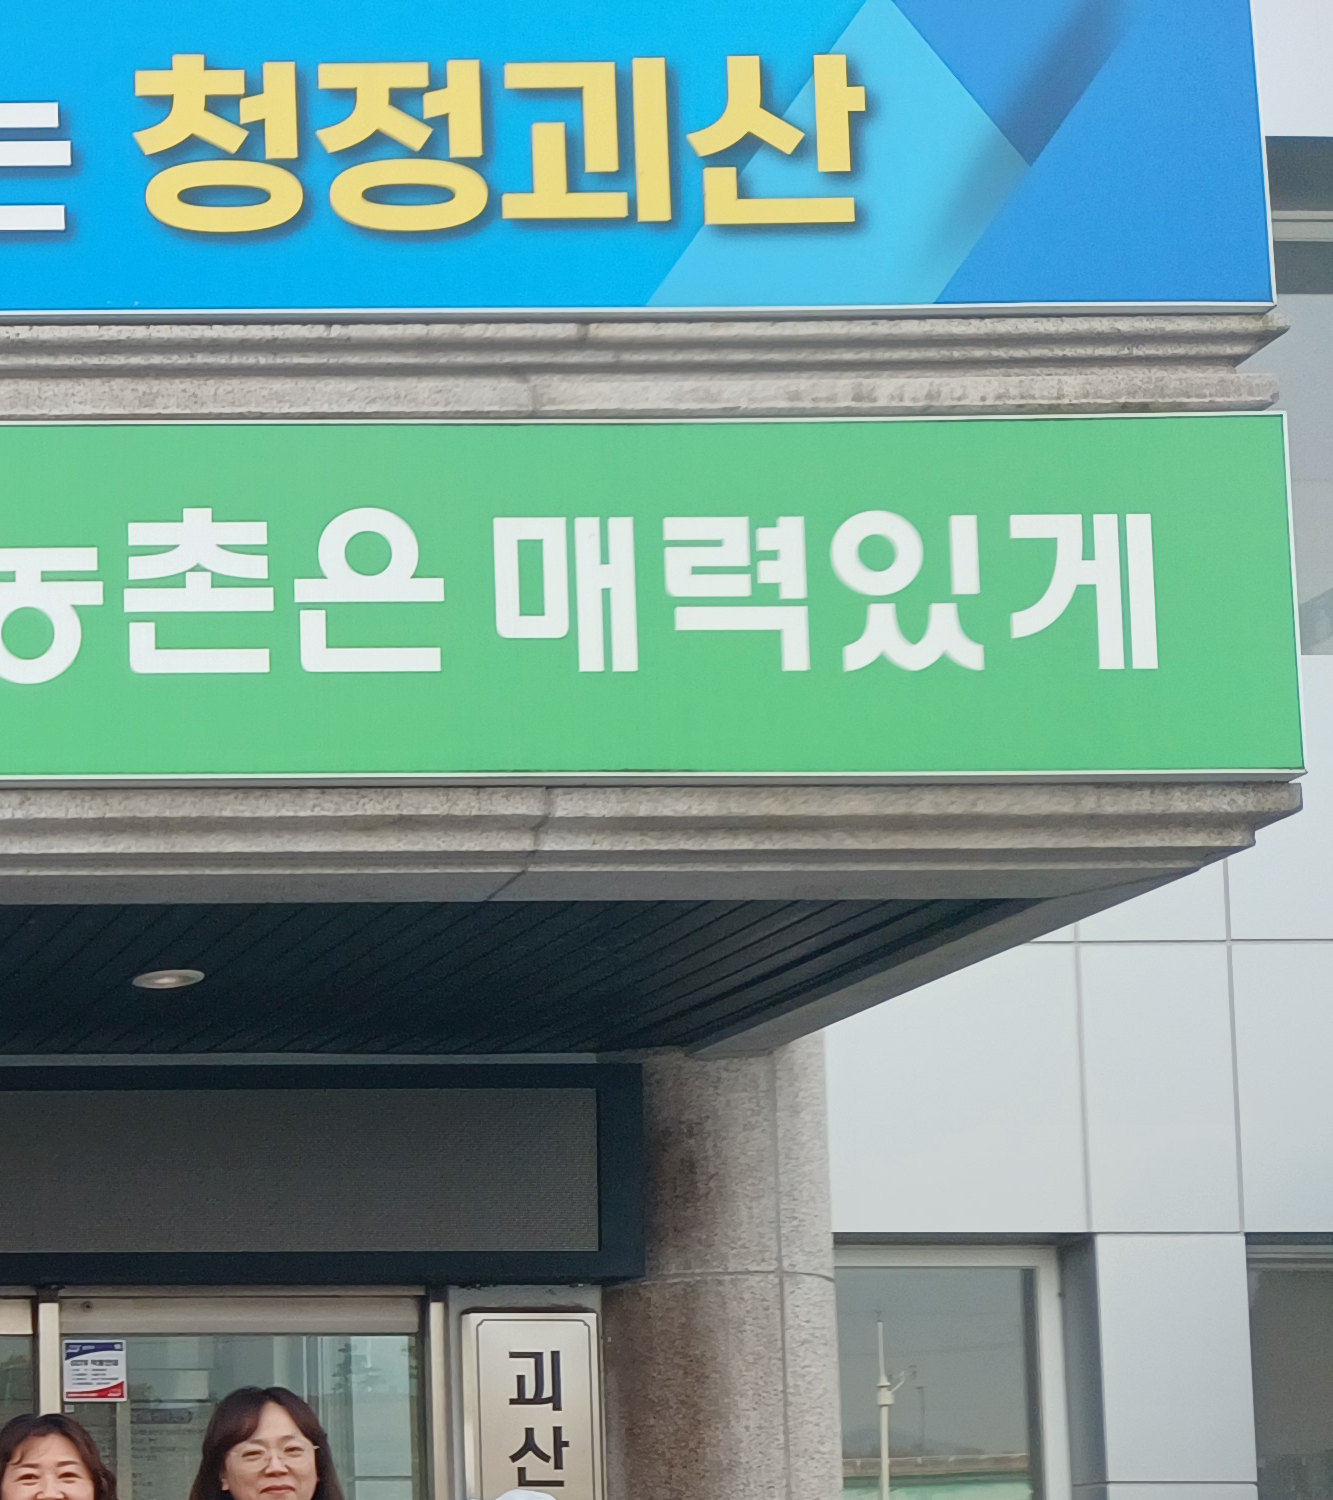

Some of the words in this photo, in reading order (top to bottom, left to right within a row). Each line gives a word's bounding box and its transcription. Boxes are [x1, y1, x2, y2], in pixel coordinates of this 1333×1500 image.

[132, 50, 869, 235] 청정괴산
[491, 508, 1161, 676] 매력있게
[507, 1350, 571, 1488] 괴산
